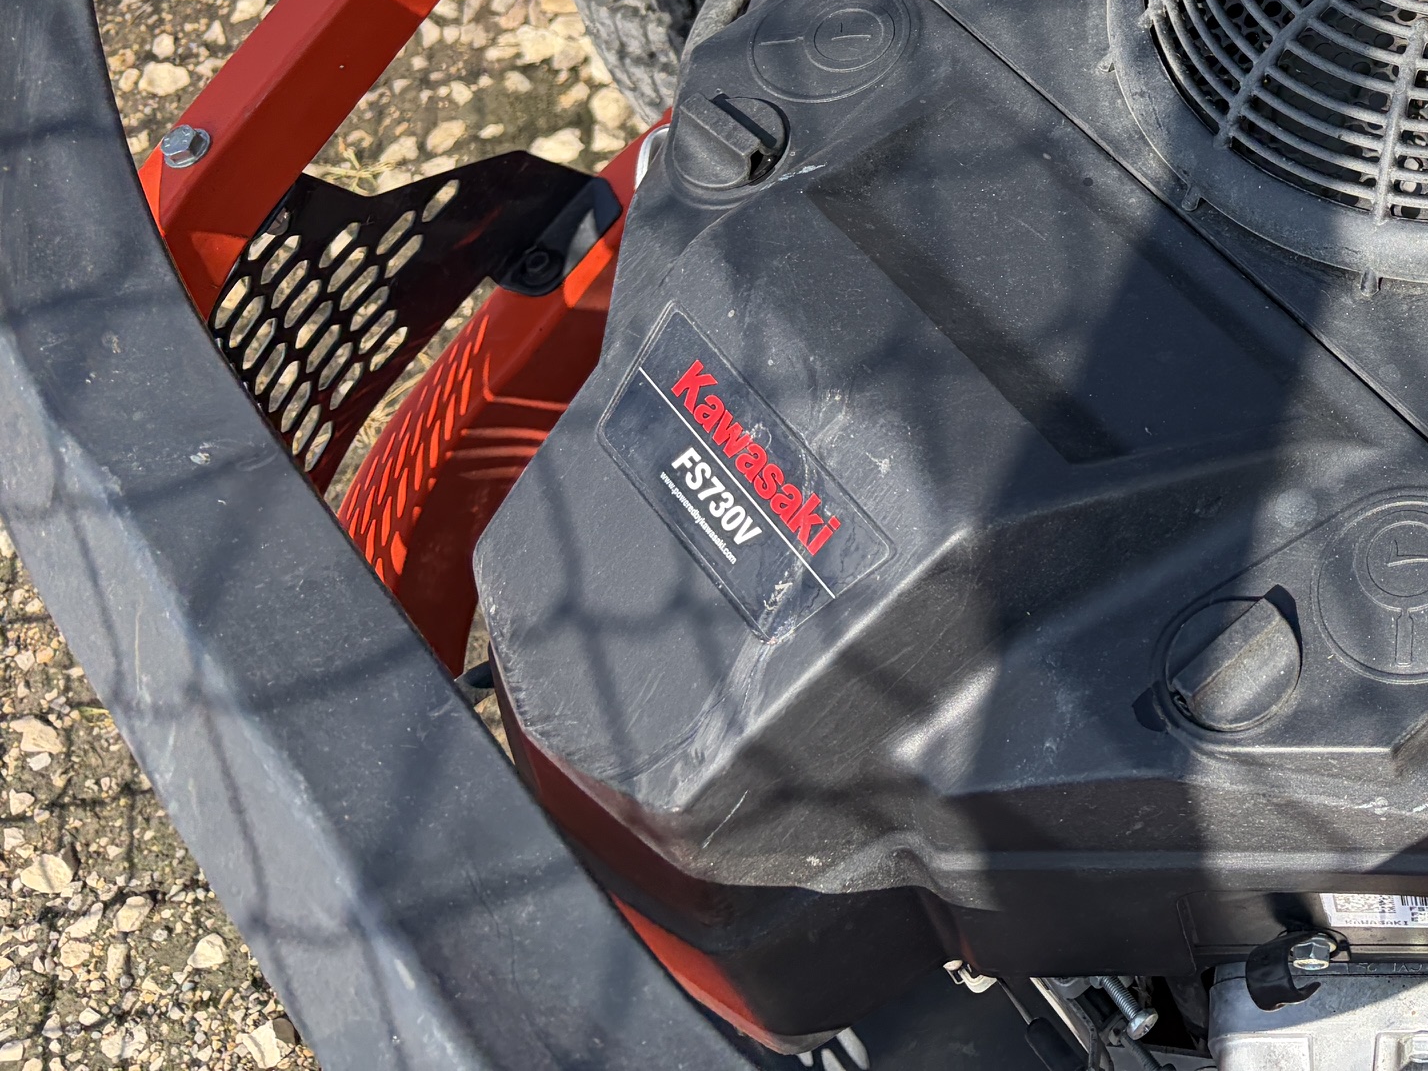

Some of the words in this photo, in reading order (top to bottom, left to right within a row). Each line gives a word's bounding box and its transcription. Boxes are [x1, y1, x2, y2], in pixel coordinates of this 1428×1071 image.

[670, 359, 842, 557] Kawasaki
[671, 446, 763, 547] FS730V
[659, 471, 737, 565] www.poweredbykawasaki.com
